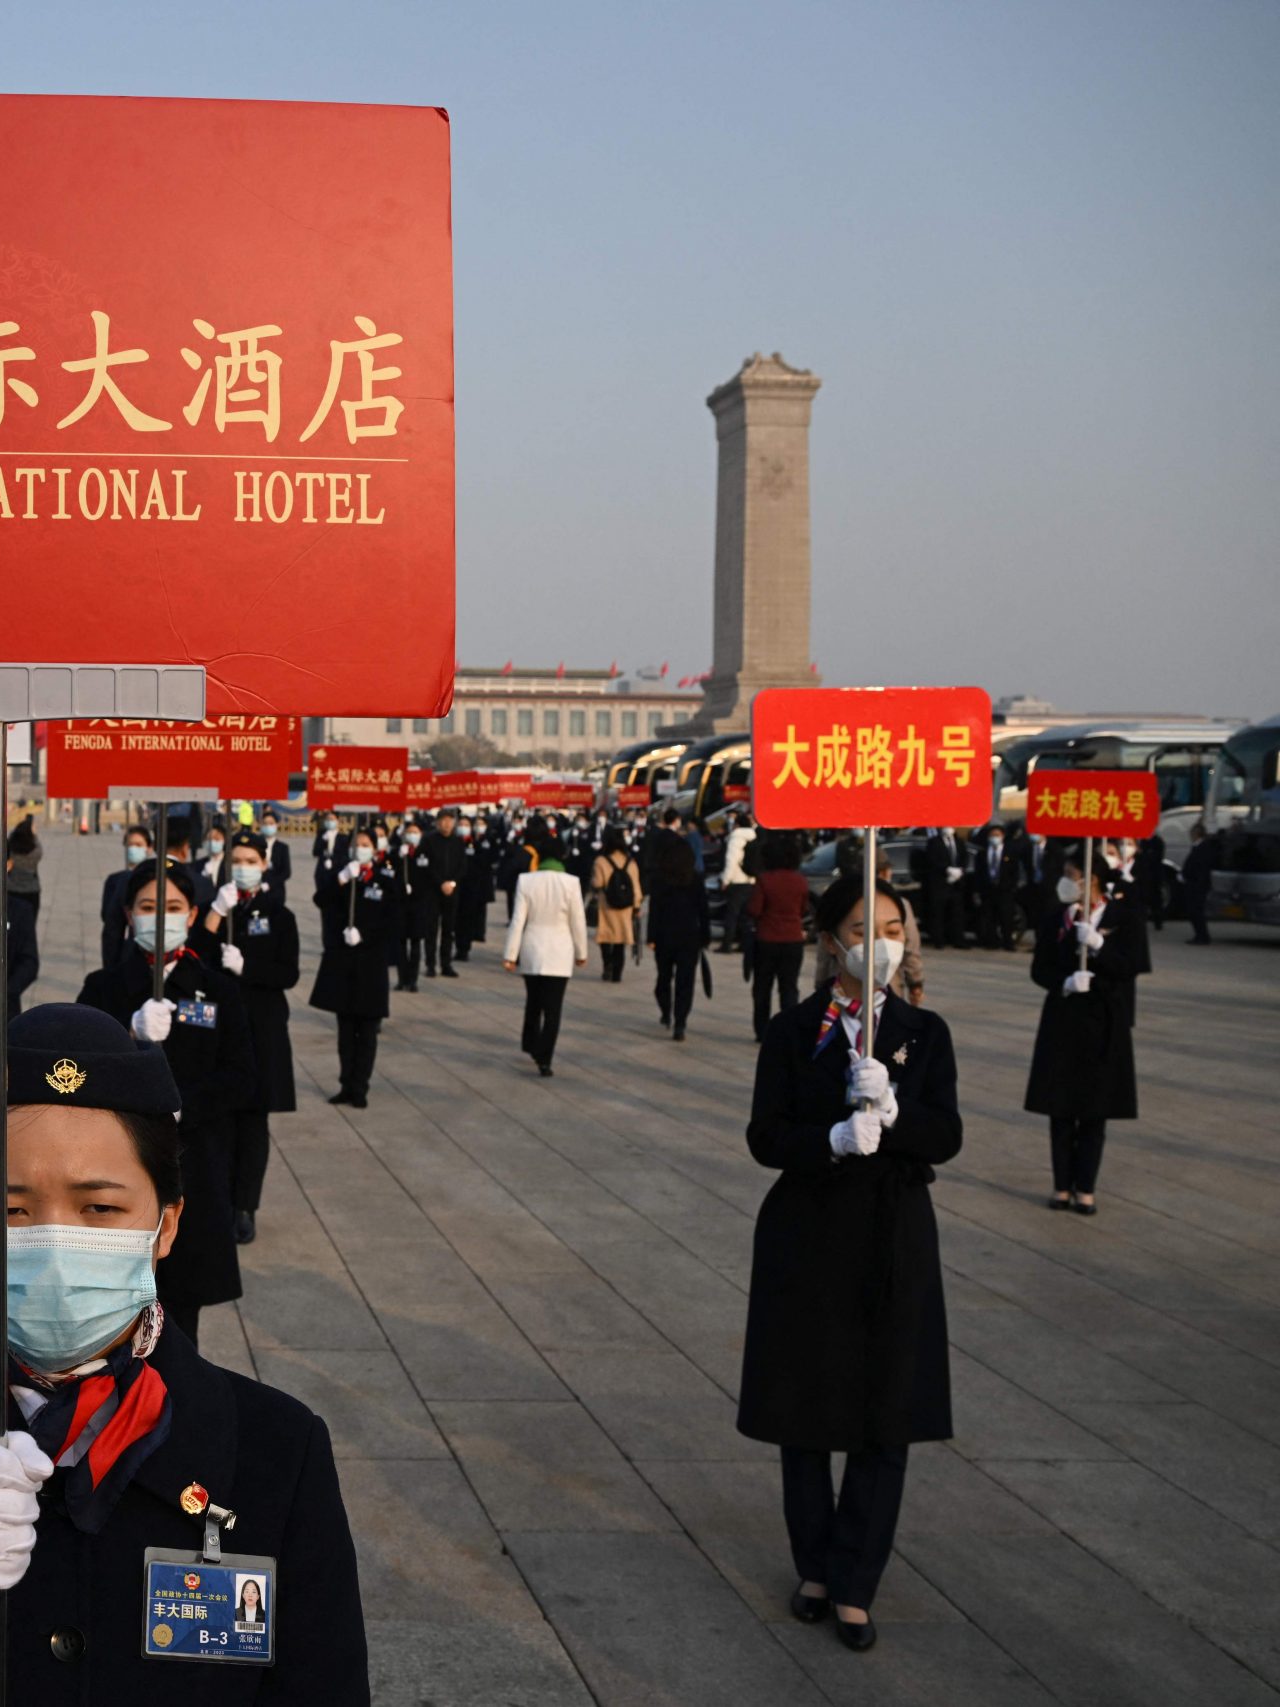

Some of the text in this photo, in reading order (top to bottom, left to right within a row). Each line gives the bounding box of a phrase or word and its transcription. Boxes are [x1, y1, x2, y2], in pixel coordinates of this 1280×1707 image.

[233, 468, 386, 527] HOTEL
[64, 734, 272, 752] FENGDA INTERNATIONAL HOTEL
[771, 723, 976, 789] 大成路九号
[1035, 788, 1146, 821] 大成路九号
[154, 1589, 228, 1602] 全国政协十四届一次会议
[153, 1602, 208, 1620] 丰大国际
[200, 1630, 228, 1645] B-3
